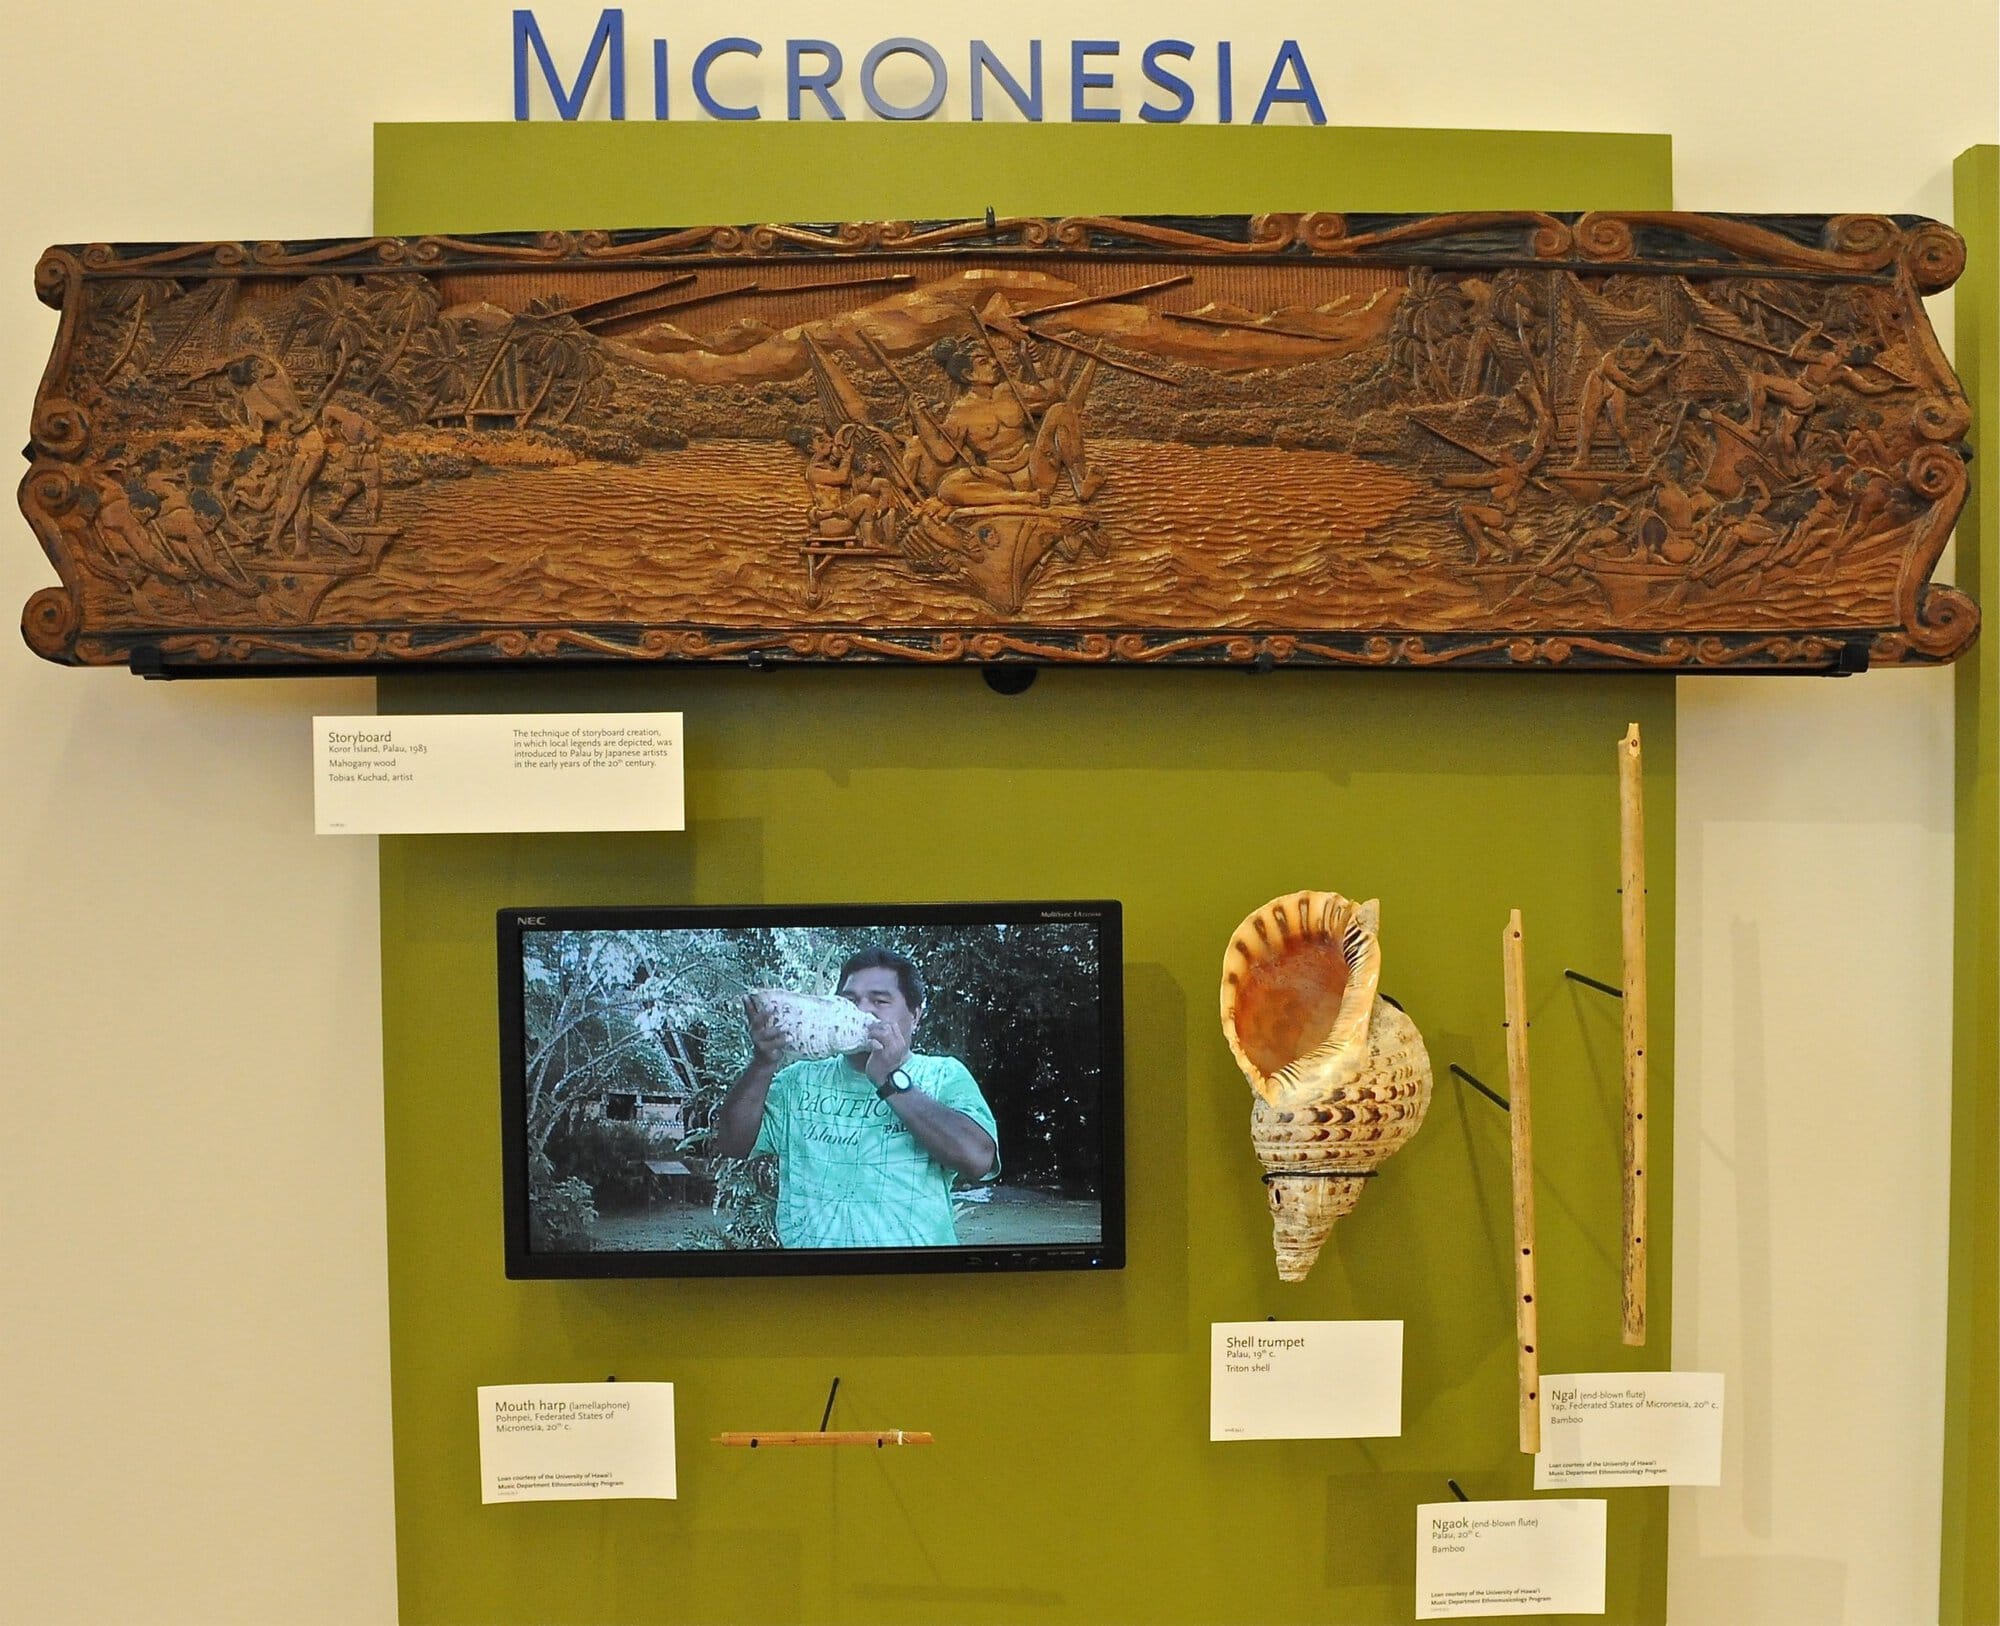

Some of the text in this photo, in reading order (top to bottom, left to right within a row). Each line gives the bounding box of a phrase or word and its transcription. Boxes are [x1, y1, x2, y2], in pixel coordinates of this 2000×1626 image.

[513, 8, 1327, 126] MICRONESIA
[329, 731, 391, 745] Storyboard
[531, 730, 570, 738] technique
[583, 729, 625, 738] storyboard
[627, 729, 661, 737] creation,
[329, 744, 427, 754] Koror Island, Palau, 1983
[514, 740, 521, 748] in
[524, 740, 547, 748] which
[550, 739, 568, 747] local
[571, 739, 601, 750] legends
[618, 739, 654, 748] depicted,
[515, 750, 557, 758] introduced
[560, 750, 567, 758] to
[594, 749, 603, 758] by
[605, 749, 640, 759] Japanese
[643, 749, 668, 757] artists
[329, 759, 396, 770] Mahogany wood
[515, 760, 522, 768] in
[524, 760, 537, 768] the
[539, 760, 557, 770] early
[560, 761, 580, 769] years
[583, 759, 591, 767] of
[593, 759, 606, 767] the
[625, 760, 656, 769] century.
[358, 773, 390, 782] Kuchad,
[517, 916, 546, 925] NEC
[798, 1090, 889, 1119] PACIFIC
[884, 1123, 908, 1134] PAL
[804, 1124, 859, 1146] Islands
[1227, 1335, 1305, 1350] Shell trumpet
[1227, 1351, 1251, 1359] Palau,
[1227, 1364, 1270, 1373] Triton shell
[1552, 1389, 1646, 1403] Ngal (end-blown flute)
[495, 1400, 630, 1413] Mouth harp (lamellaphone)
[1551, 1403, 1567, 1412] Yap,
[1570, 1401, 1608, 1410] Federated
[1610, 1401, 1634, 1409] States
[1636, 1400, 1644, 1409] of
[1646, 1400, 1691, 1409] Micronesia,
[496, 1411, 614, 1423] Pohnpei, Federated States of
[1551, 1416, 1583, 1425] Bamboo
[497, 1423, 544, 1433] Micronesia,
[1432, 1518, 1538, 1532] Ngaok (end-blown flute)
[1432, 1532, 1455, 1540] Palau,
[1432, 1545, 1465, 1554] Bamboo
